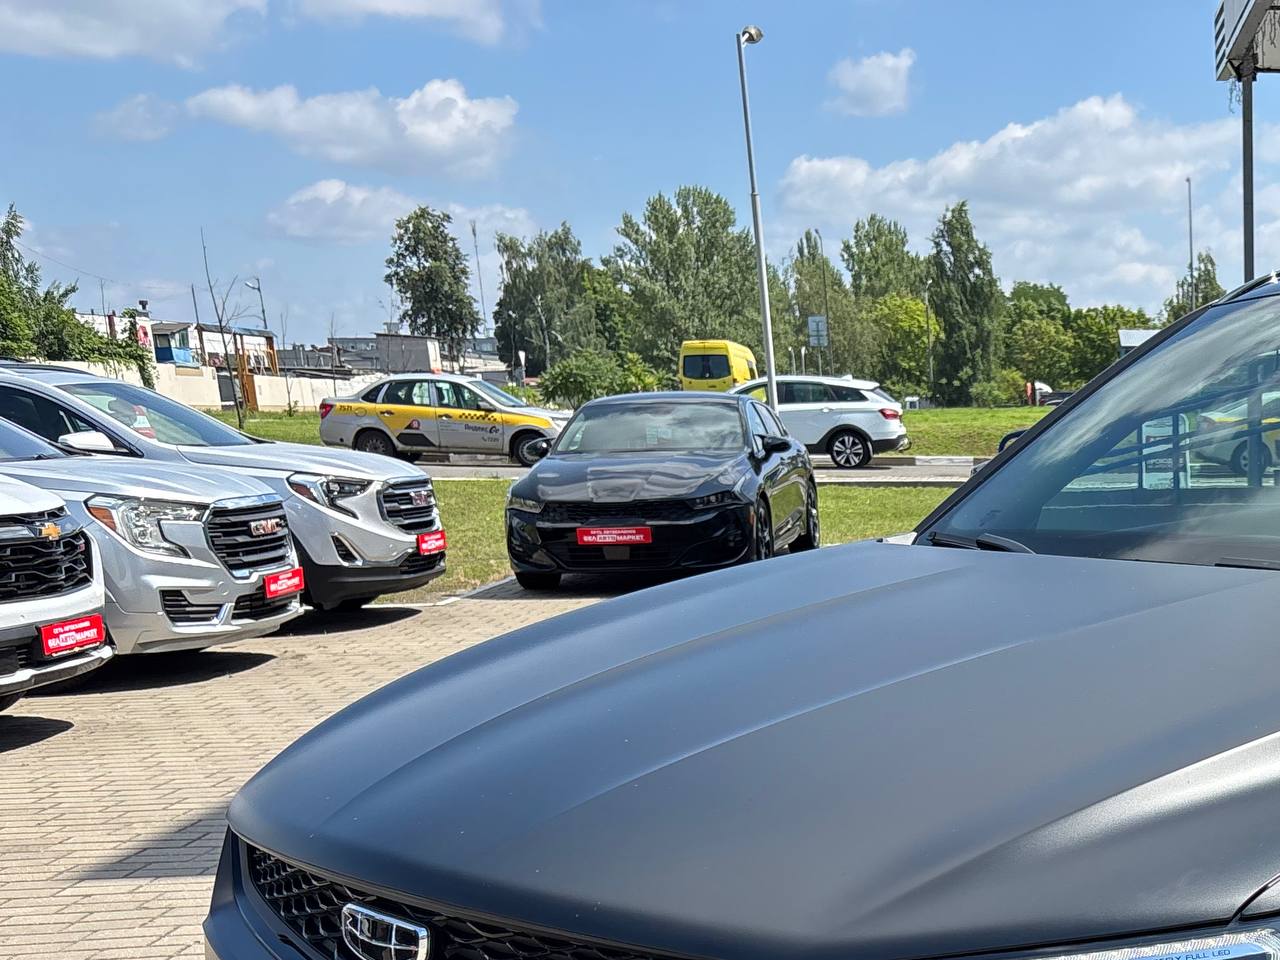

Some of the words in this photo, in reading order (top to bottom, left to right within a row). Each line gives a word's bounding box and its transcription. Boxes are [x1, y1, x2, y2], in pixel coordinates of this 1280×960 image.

[250, 518, 282, 536] GMC
[1185, 952, 1209, 960] FULL
[1211, 949, 1231, 958] LED
